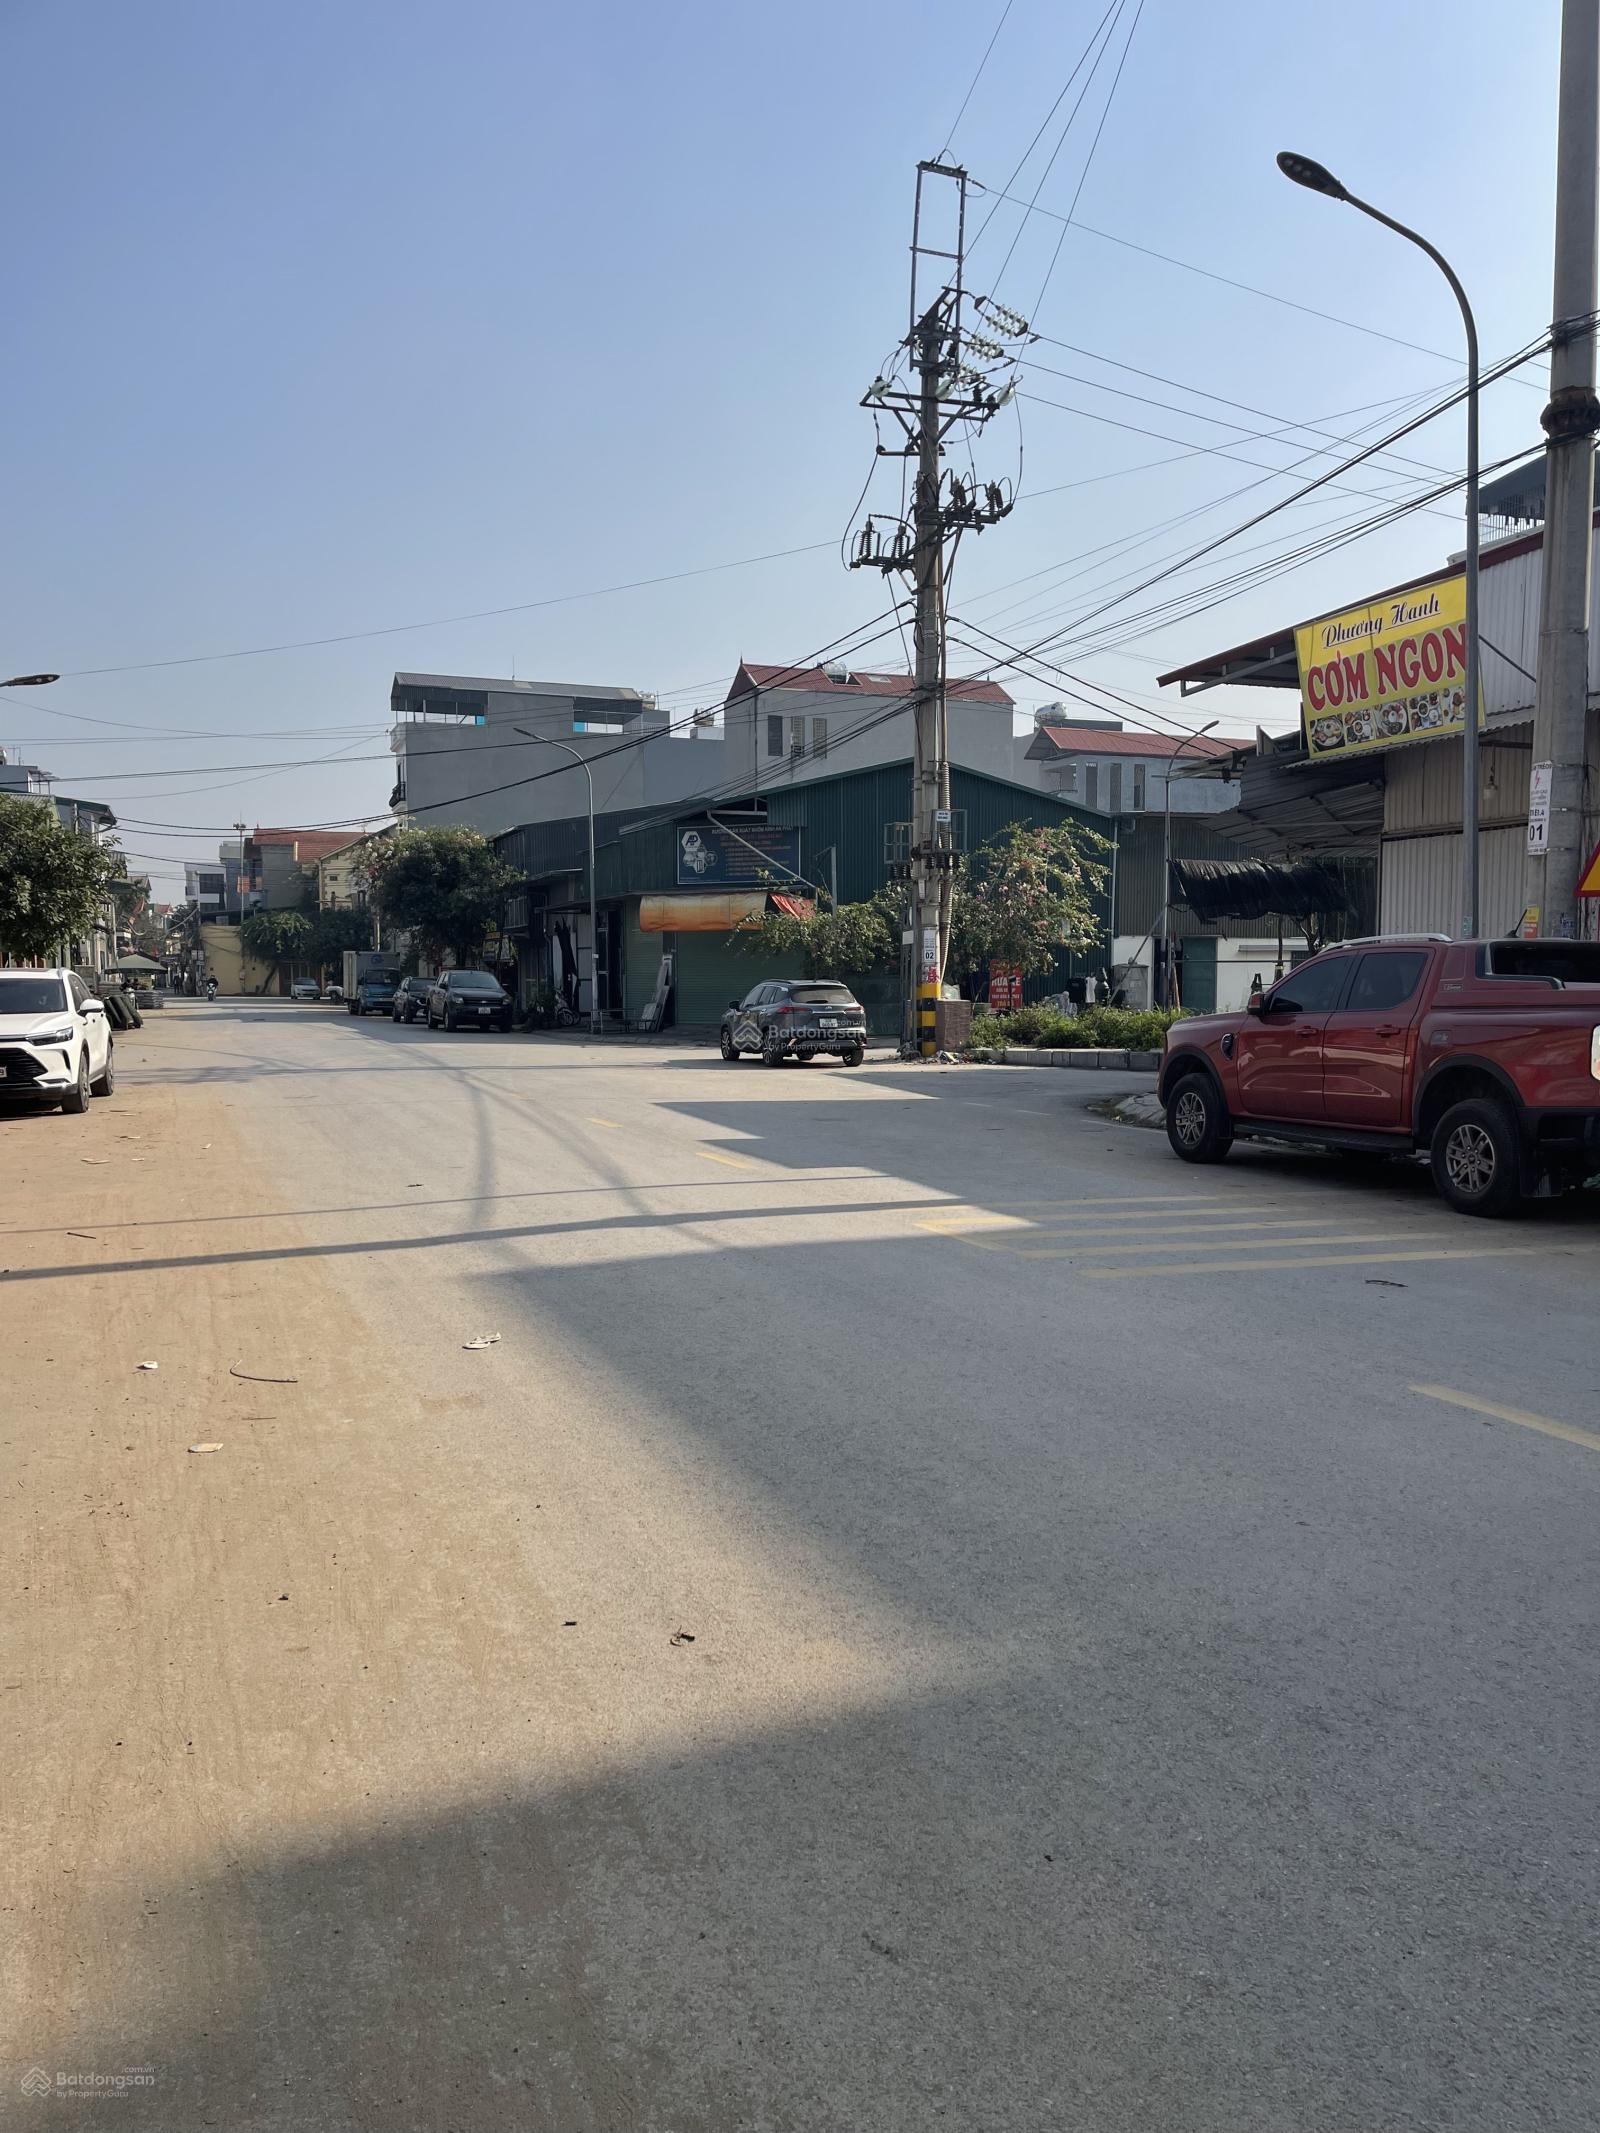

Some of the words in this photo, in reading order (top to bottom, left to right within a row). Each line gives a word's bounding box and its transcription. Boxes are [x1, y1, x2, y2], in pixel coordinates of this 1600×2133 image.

[1307, 650, 1369, 711] CƠM
[1374, 623, 1466, 695] NGON
[1529, 823, 1543, 841] 01
